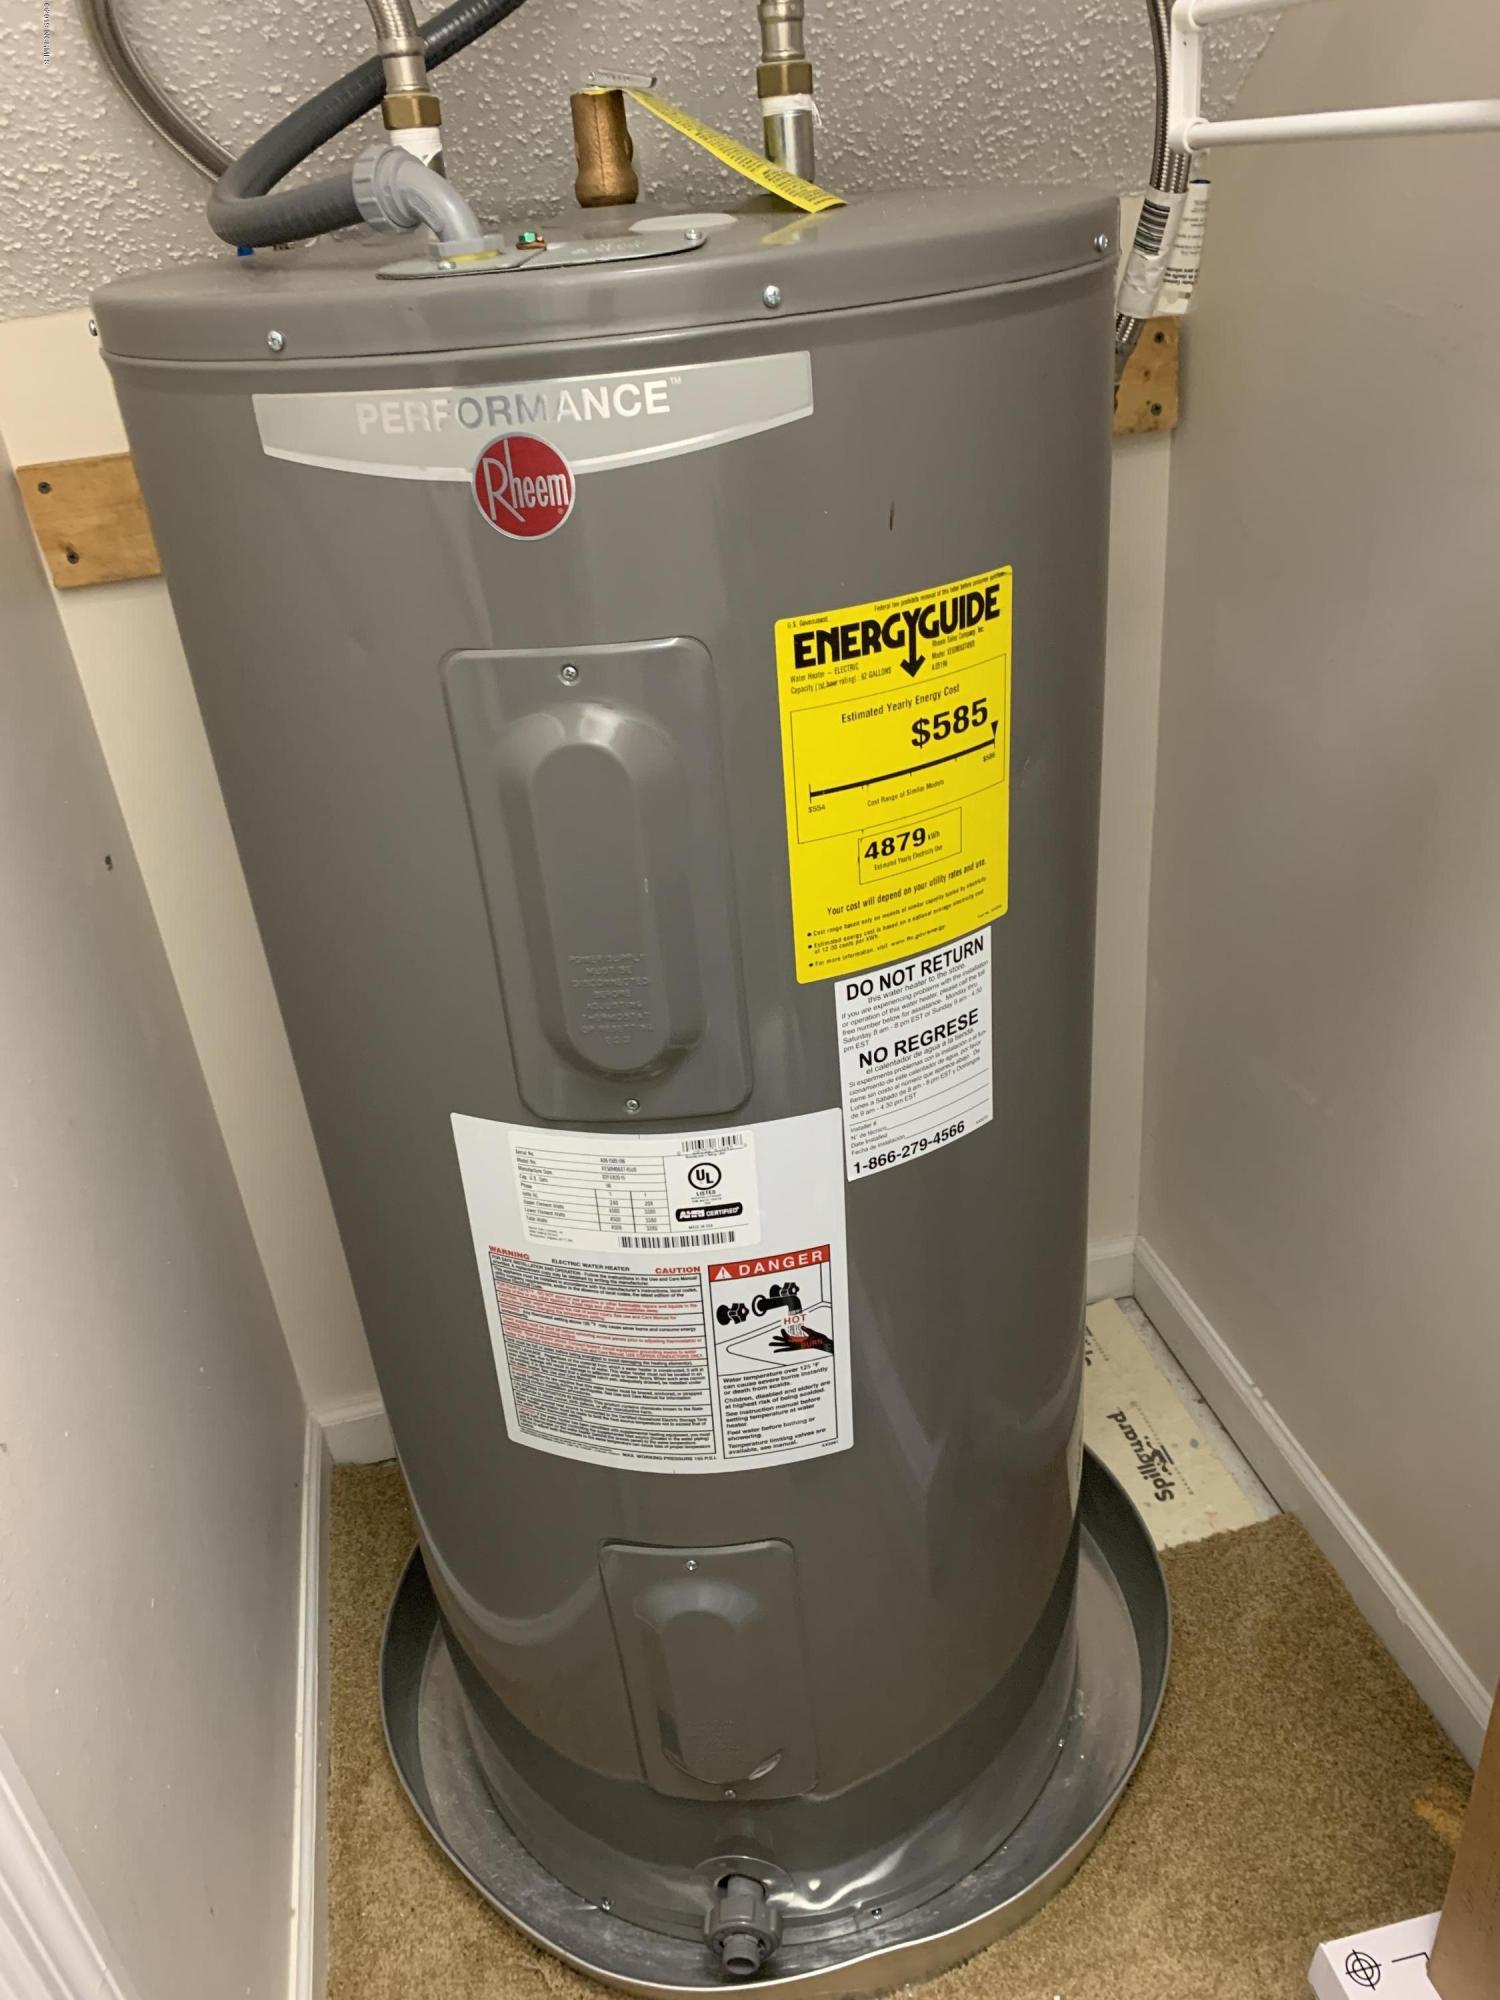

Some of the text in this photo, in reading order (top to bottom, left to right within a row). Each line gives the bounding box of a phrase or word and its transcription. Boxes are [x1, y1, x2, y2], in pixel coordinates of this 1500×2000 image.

[483, 439, 570, 523] Rheem
[793, 583, 1001, 674] ENERGYGUIDE
[834, 662, 858, 675] ELECTRIC
[869, 666, 891, 679] GALLONS
[842, 682, 960, 723] Estimated Yearly Energy Cost
[911, 697, 988, 749] $585
[868, 778, 944, 809] Cost Range Similar Models
[864, 828, 926, 860] 4879
[827, 904, 844, 917] Your
[846, 900, 860, 914] cost
[863, 897, 875, 910] will
[877, 889, 902, 906] depend
[903, 886, 912, 899] on
[914, 880, 927, 895] your
[929, 873, 946, 889] utility
[948, 866, 962, 882] rates
[964, 860, 974, 875] and
[846, 935, 984, 1002] DO NOT RETURN
[847, 1010, 859, 1019] you
[861, 1006, 872, 1015] are
[873, 993, 912, 1012] experiencing
[913, 982, 939, 998] problems
[940, 976, 952, 987] with
[953, 972, 961, 982] the
[962, 959, 989, 977] installation
[868, 994, 881, 1004] this
[882, 986, 904, 1000] water
[905, 977, 927, 992] heater
[929, 974, 935, 983] to
[937, 969, 947, 980] the
[842, 1028, 855, 1036] free
[857, 1020, 881, 1032] number
[882, 1013, 900, 1024] below
[945, 986, 966, 1000] Monday
[968, 981, 978, 991] thru
[850, 1012, 881, 1026] operation
[881, 1009, 887, 1017] of
[890, 1005, 900, 1014] this
[902, 998, 918, 1010] water
[940, 982, 958, 995] please
[959, 978, 967, 987] call
[968, 974, 977, 983] the
[843, 1000, 952, 1045] Saturday am pm EST or Sunday
[844, 1039, 869, 1053] pm EST
[859, 1007, 979, 1069] NO REGRESE
[866, 1067, 873, 1076] el
[874, 1053, 912, 1073] calentador
[913, 1049, 923, 1059] de
[924, 1042, 940, 1056] agua
[947, 1036, 954, 1045] la
[905, 1092, 917, 1102] EST
[850, 1122, 872, 1133] Installer
[851, 1140, 864, 1148] Date
[852, 1147, 867, 1156] Fecha
[854, 1118, 965, 1175] 1-866-279-4566
[695, 1168, 714, 1185] UL
[696, 1189, 717, 1197] LISTED
[488, 1245, 530, 1260] WARNING
[739, 1250, 822, 1276] DANGER
[551, 1257, 631, 1273] ELECTRIC WATER HEATER
[654, 1266, 701, 1274] CAUTION
[784, 1313, 807, 1325] HOT
[737, 1380, 757, 1388] cause
[758, 1377, 779, 1386] severe
[781, 1373, 799, 1382] burns
[801, 1367, 828, 1378] instantly
[743, 1370, 783, 1382] temperature
[784, 1367, 798, 1375] over
[755, 1390, 783, 1400] disabled
[784, 1388, 797, 1396] and
[798, 1383, 819, 1393] elderly
[821, 1380, 831, 1388] are
[732, 1401, 757, 1409] highest
[758, 1398, 771, 1406] risk
[780, 1393, 798, 1402] being
[740, 1405, 774, 1415] instruction
[776, 1401, 799, 1410] manual
[800, 1396, 821, 1406] before
[726, 1415, 749, 1423] setting
[749, 1409, 789, 1421] temperature
[798, 1403, 815, 1413] water
[761, 1423, 783, 1431] before
[784, 1418, 807, 1428] bathing
[728, 1427, 827, 1449] Temperature limiting valves are
[1106, 1411, 1175, 1502] Spillguard
